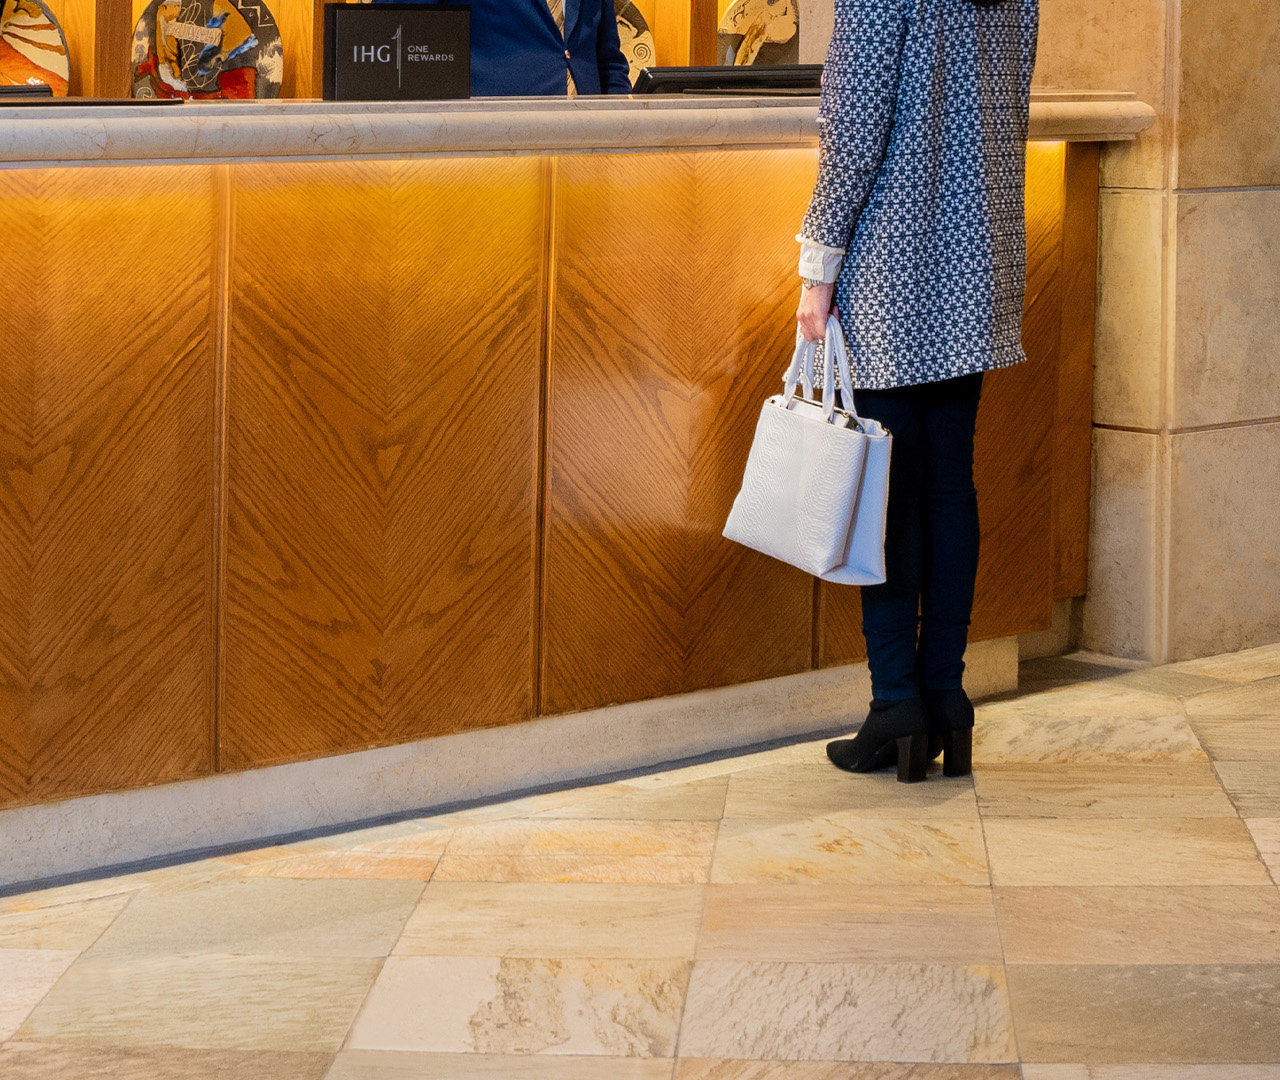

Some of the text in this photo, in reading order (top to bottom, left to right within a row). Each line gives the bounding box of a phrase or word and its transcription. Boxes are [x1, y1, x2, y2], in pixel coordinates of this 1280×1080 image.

[353, 44, 391, 63] IHG
[407, 45, 428, 53] ONE
[407, 53, 455, 62] REWARDS
